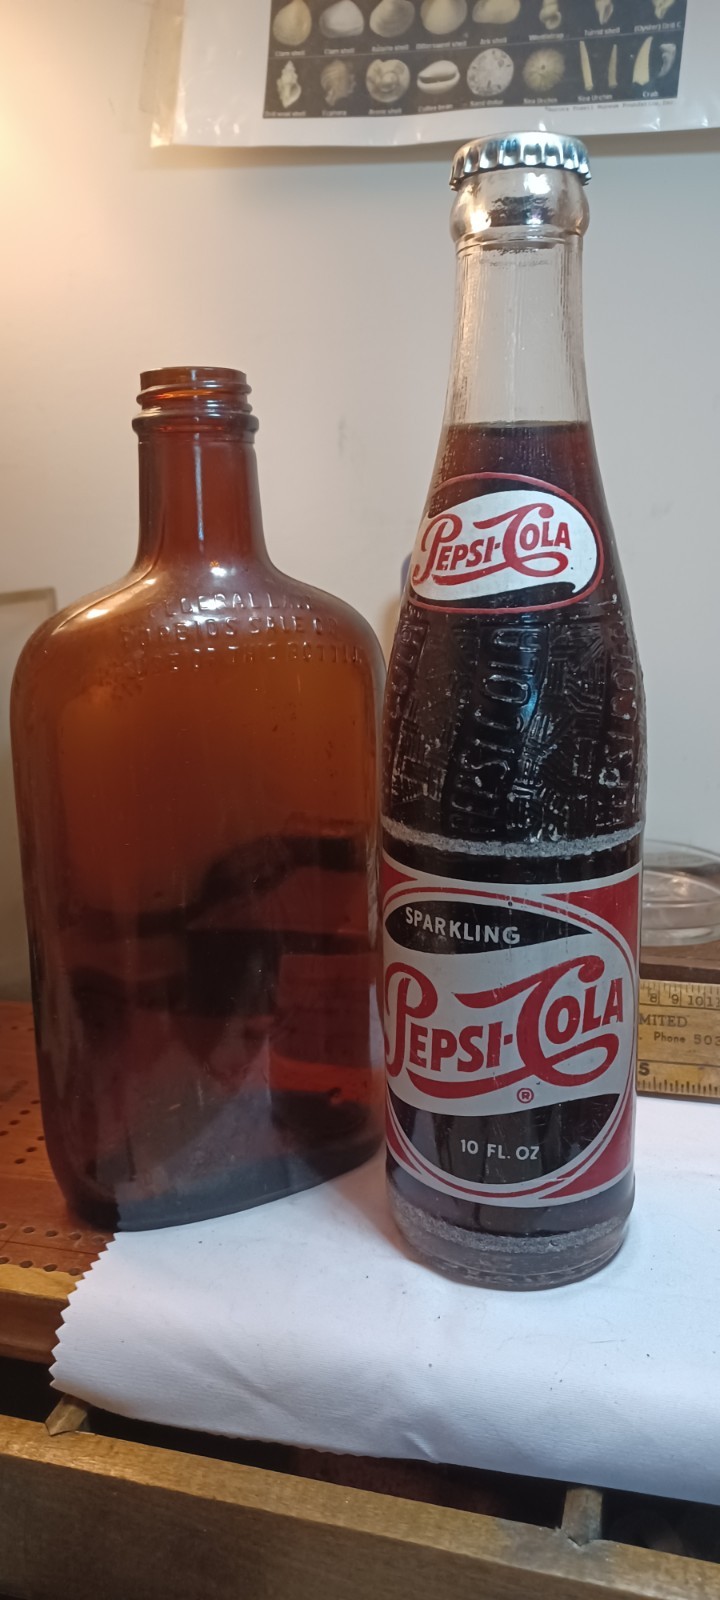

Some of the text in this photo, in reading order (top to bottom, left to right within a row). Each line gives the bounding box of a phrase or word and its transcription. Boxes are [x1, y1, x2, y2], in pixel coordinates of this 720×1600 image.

[642, 90, 659, 98] Crab
[405, 906, 521, 945] SPARKLING
[650, 993, 658, 1003] 8
[672, 994, 679, 1004] 9
[688, 995, 703, 1008] 10
[653, 1031, 686, 1044] Phone
[460, 1138, 540, 1161] 10 FL. OZ
